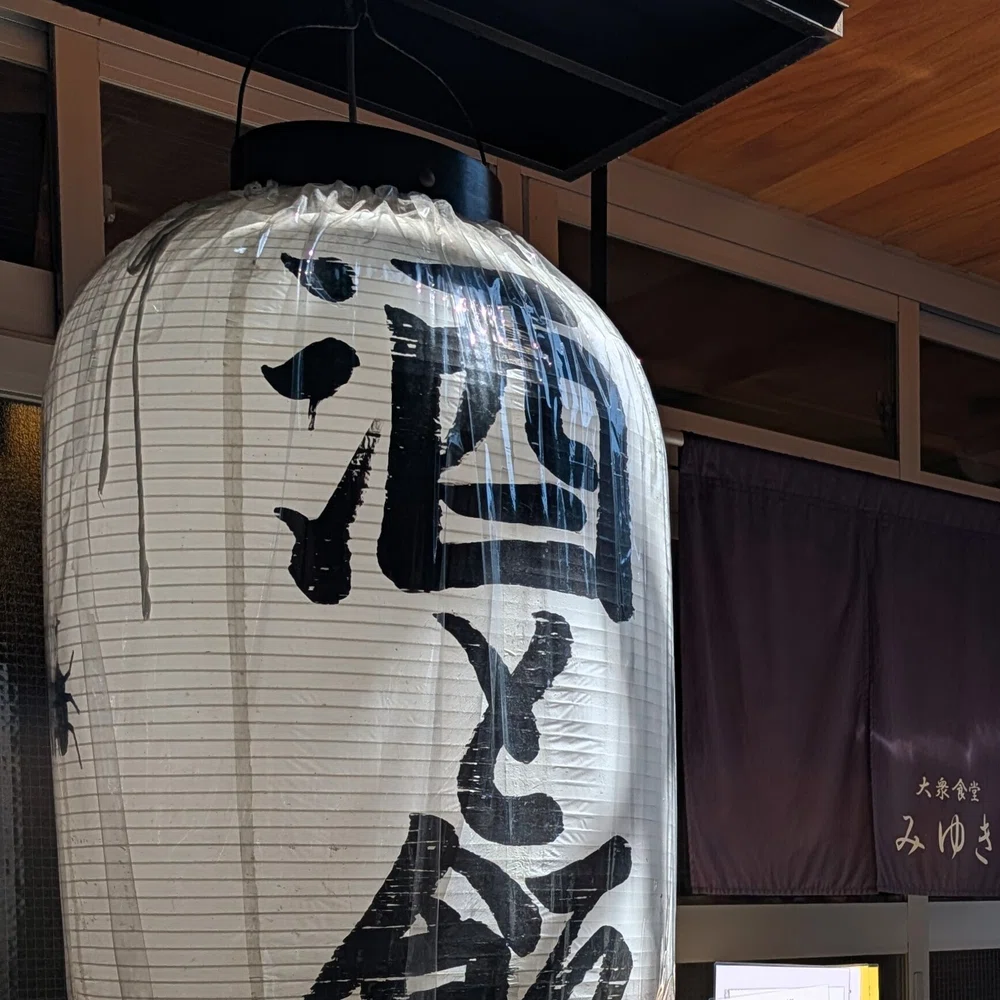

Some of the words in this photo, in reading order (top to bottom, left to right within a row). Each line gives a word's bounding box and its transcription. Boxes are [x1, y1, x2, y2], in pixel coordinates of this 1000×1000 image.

[915, 776, 981, 803] 大衆食堂
[895, 813, 993, 866] みゆき
